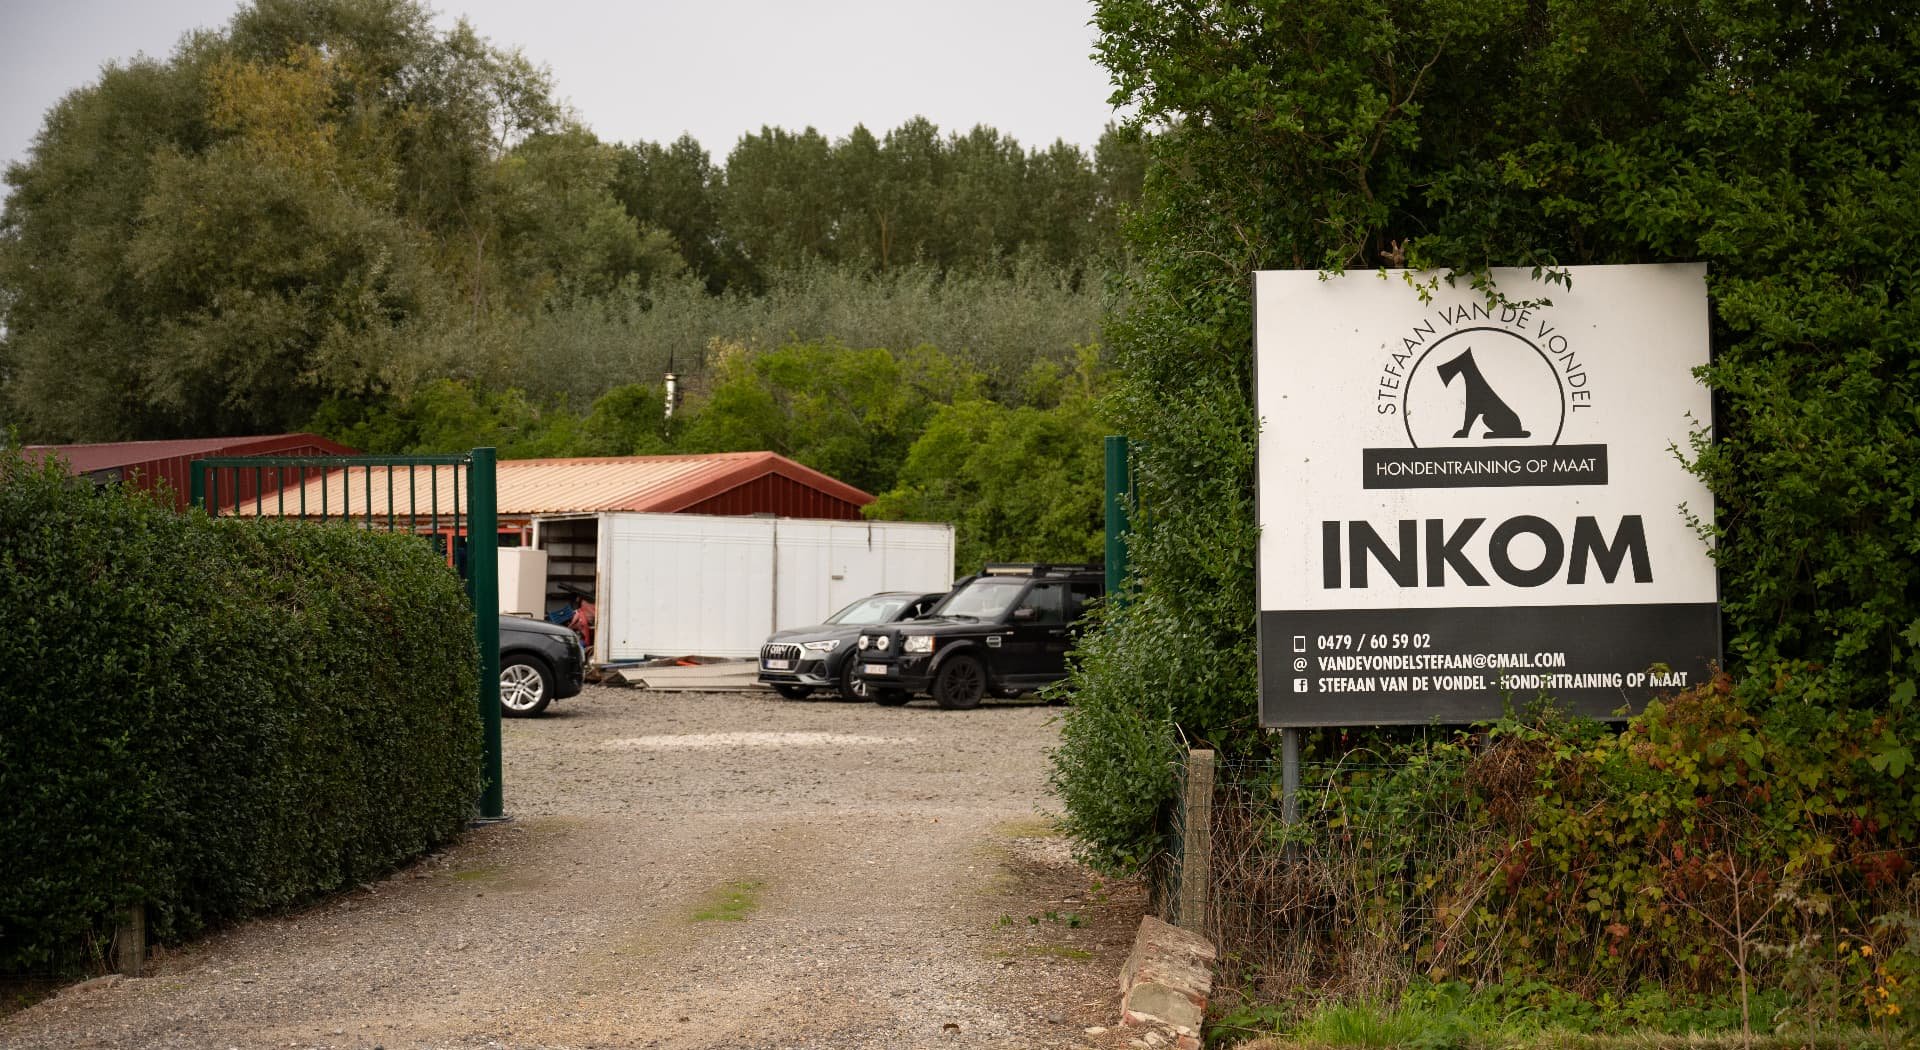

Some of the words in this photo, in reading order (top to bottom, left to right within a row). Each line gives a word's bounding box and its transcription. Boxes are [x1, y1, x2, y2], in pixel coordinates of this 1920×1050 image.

[1377, 319, 1436, 415] STEFAAN
[1438, 301, 1490, 326] VAN
[1500, 306, 1532, 330] DE
[1537, 320, 1591, 412] VONDEL
[1376, 460, 1521, 476] HONDENTRAINING
[1526, 459, 1548, 473] OP
[1552, 458, 1597, 472] MAAT
[1322, 514, 1654, 589] INKOM
[1317, 635, 1352, 650] 0479
[1356, 633, 1367, 652] /
[1370, 634, 1388, 649] 60
[1392, 634, 1409, 649] 59
[1413, 633, 1431, 648] 02
[1318, 652, 1566, 671] VANDEVONDELSTEFAAN@GMAIL.COM
[1318, 677, 1376, 693] STEFAAN
[1379, 677, 1408, 692] VAN
[1412, 676, 1429, 691] DE
[1433, 675, 1487, 691] VONDEL
[1626, 672, 1646, 688] OP
[1649, 671, 1688, 687] MAAT
